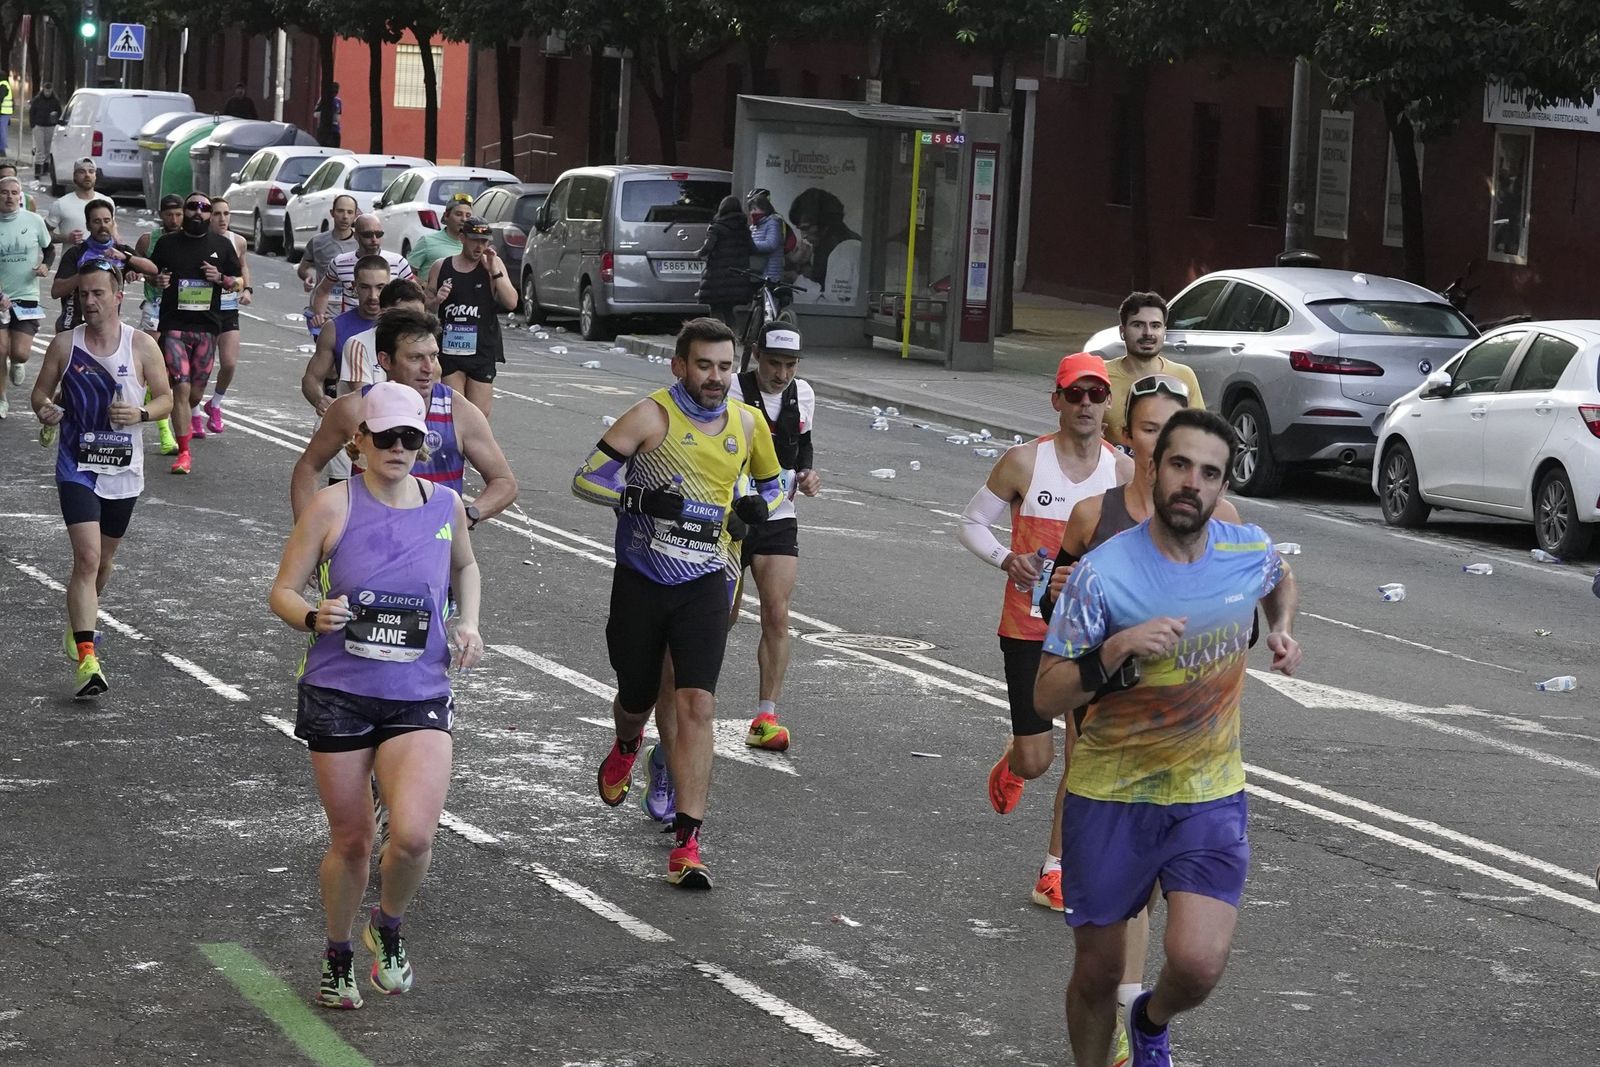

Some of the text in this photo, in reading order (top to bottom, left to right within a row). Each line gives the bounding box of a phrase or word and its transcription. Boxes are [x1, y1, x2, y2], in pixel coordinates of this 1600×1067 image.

[921, 134, 965, 143] C2 5 6 43
[664, 261, 705, 271] 5865 KNT
[447, 341, 471, 349] TAYLER
[98, 433, 127, 443] ZURICH
[87, 453, 123, 465] MONTY
[686, 504, 719, 517] ZURICH
[682, 521, 702, 533] 4629
[654, 530, 687, 547] SUÁREZ
[688, 540, 716, 552] ROVIRA
[380, 595, 425, 607] ZURICH
[377, 613, 402, 625] 5024
[367, 626, 407, 645] JANE
